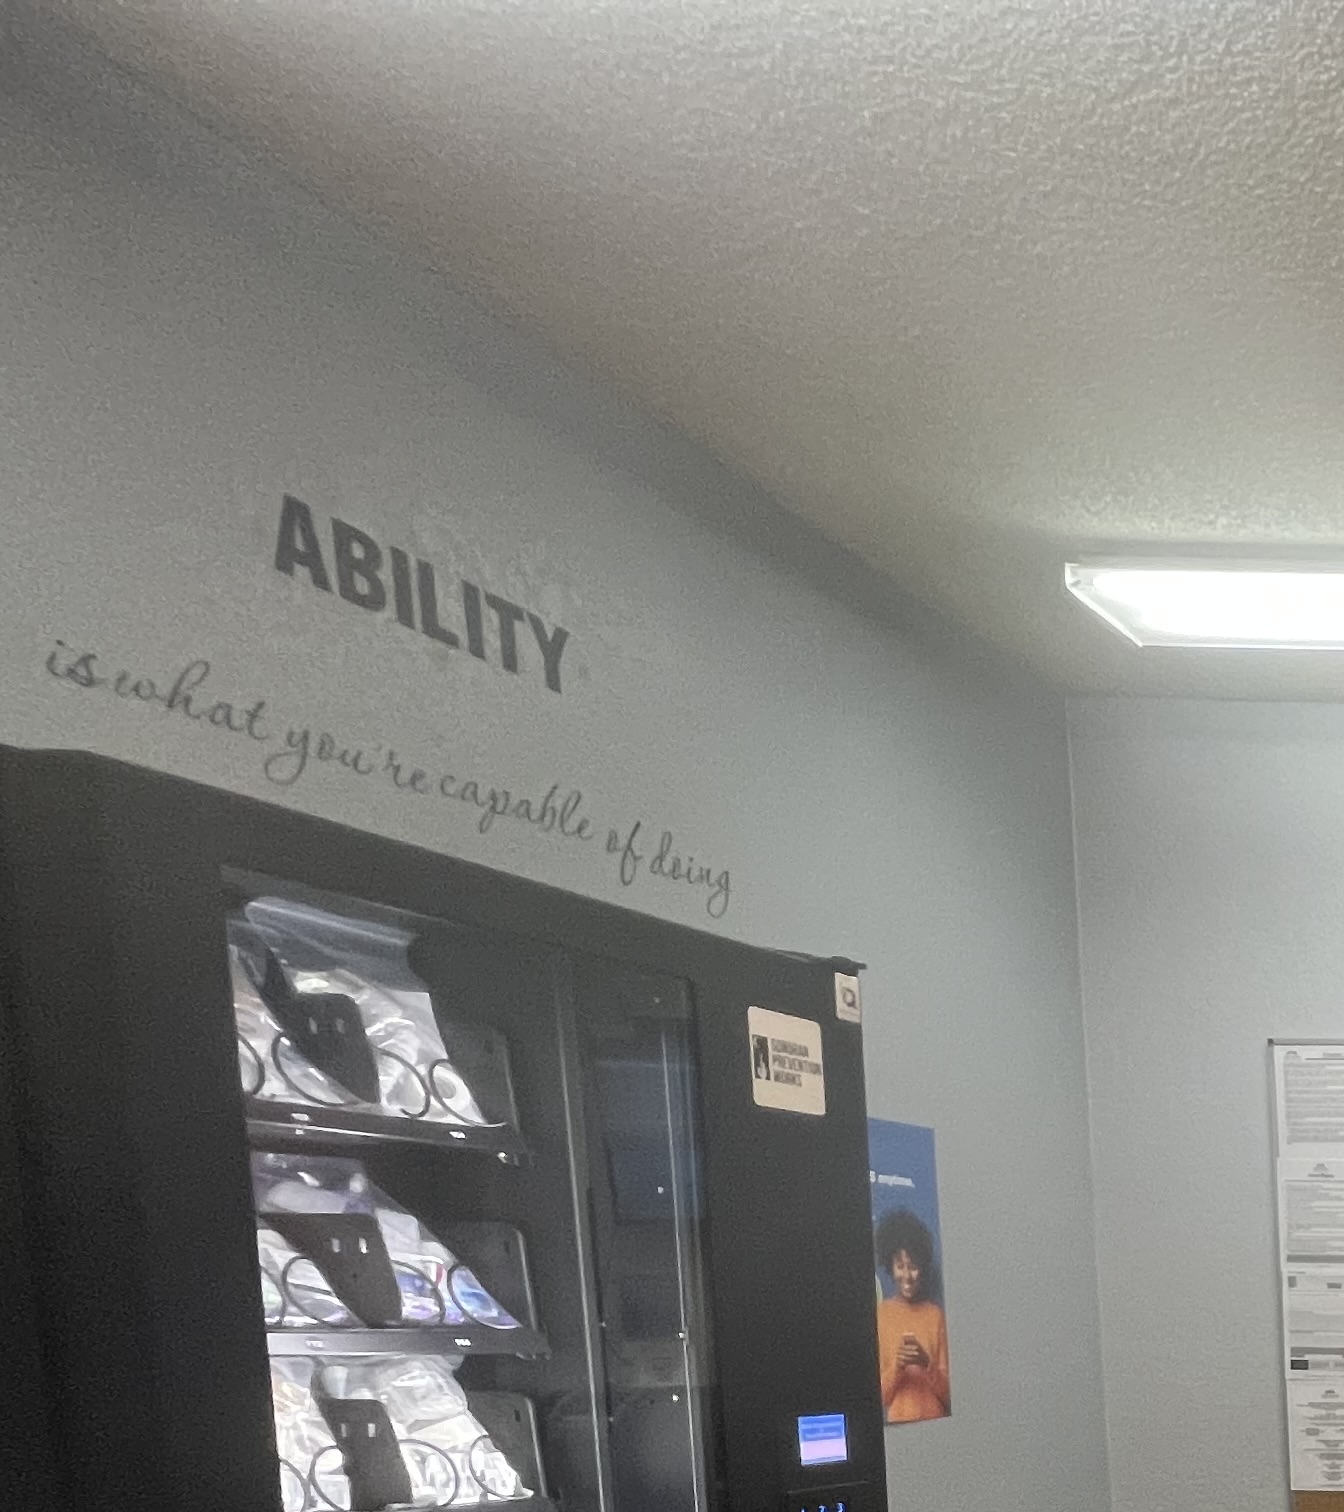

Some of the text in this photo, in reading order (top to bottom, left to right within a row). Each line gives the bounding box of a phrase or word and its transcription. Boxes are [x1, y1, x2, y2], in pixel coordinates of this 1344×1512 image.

[273, 493, 570, 694] ABILITY
[45, 638, 734, 918] is what you're capable of doing
